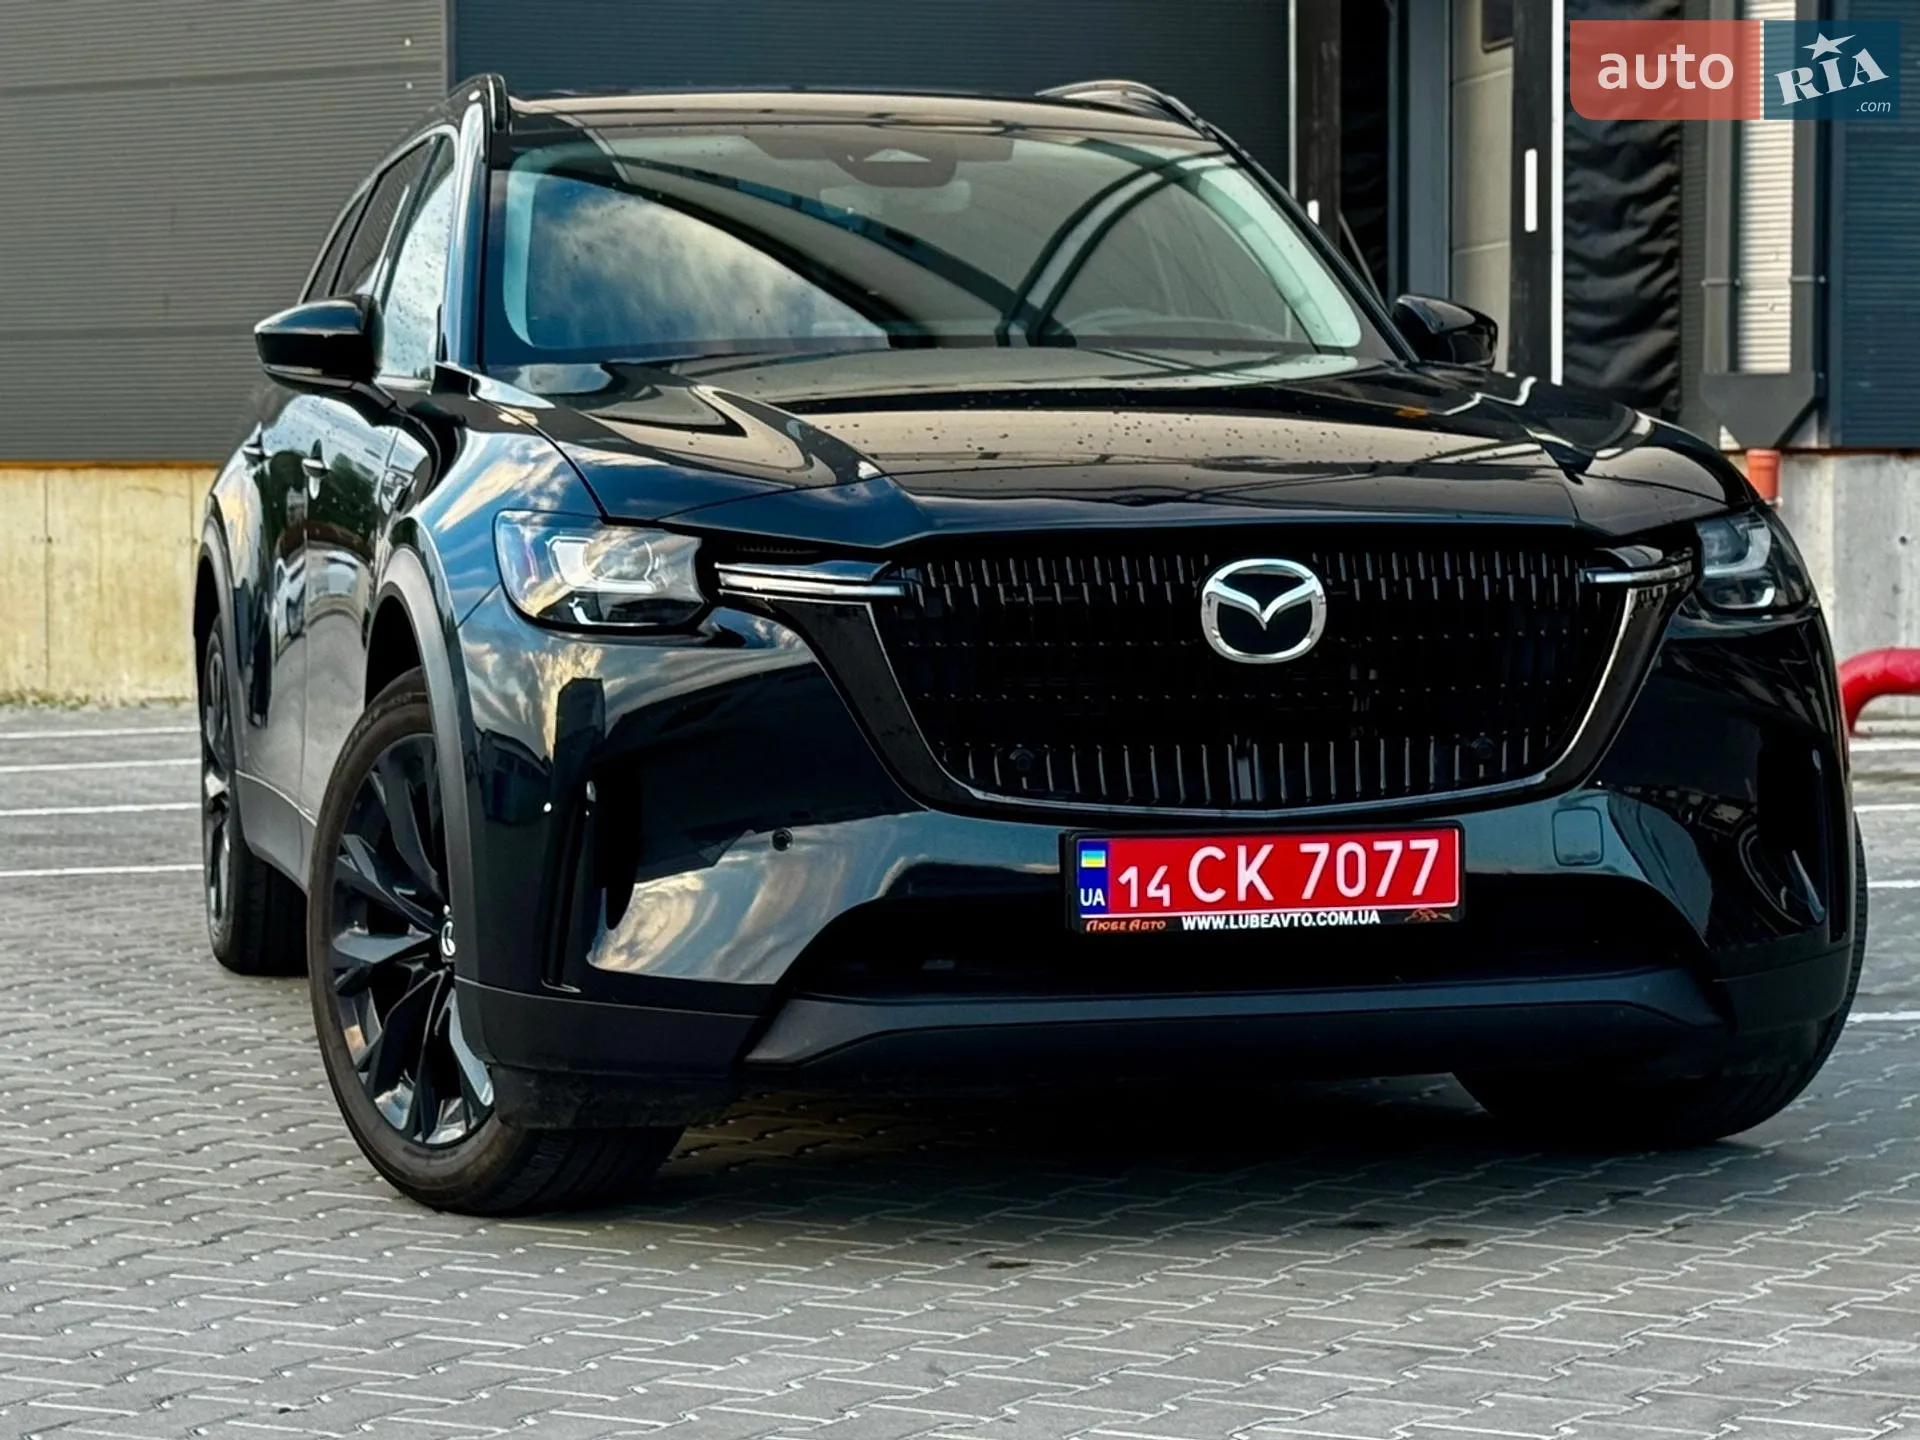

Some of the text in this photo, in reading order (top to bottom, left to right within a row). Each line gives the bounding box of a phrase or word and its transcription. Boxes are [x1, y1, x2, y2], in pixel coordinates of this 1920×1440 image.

[1118, 838, 1440, 908] 14 CK 7077
[1080, 888, 1105, 907] UA
[1181, 909, 1381, 931] WWW.LUBEAVTO.COM.UA
